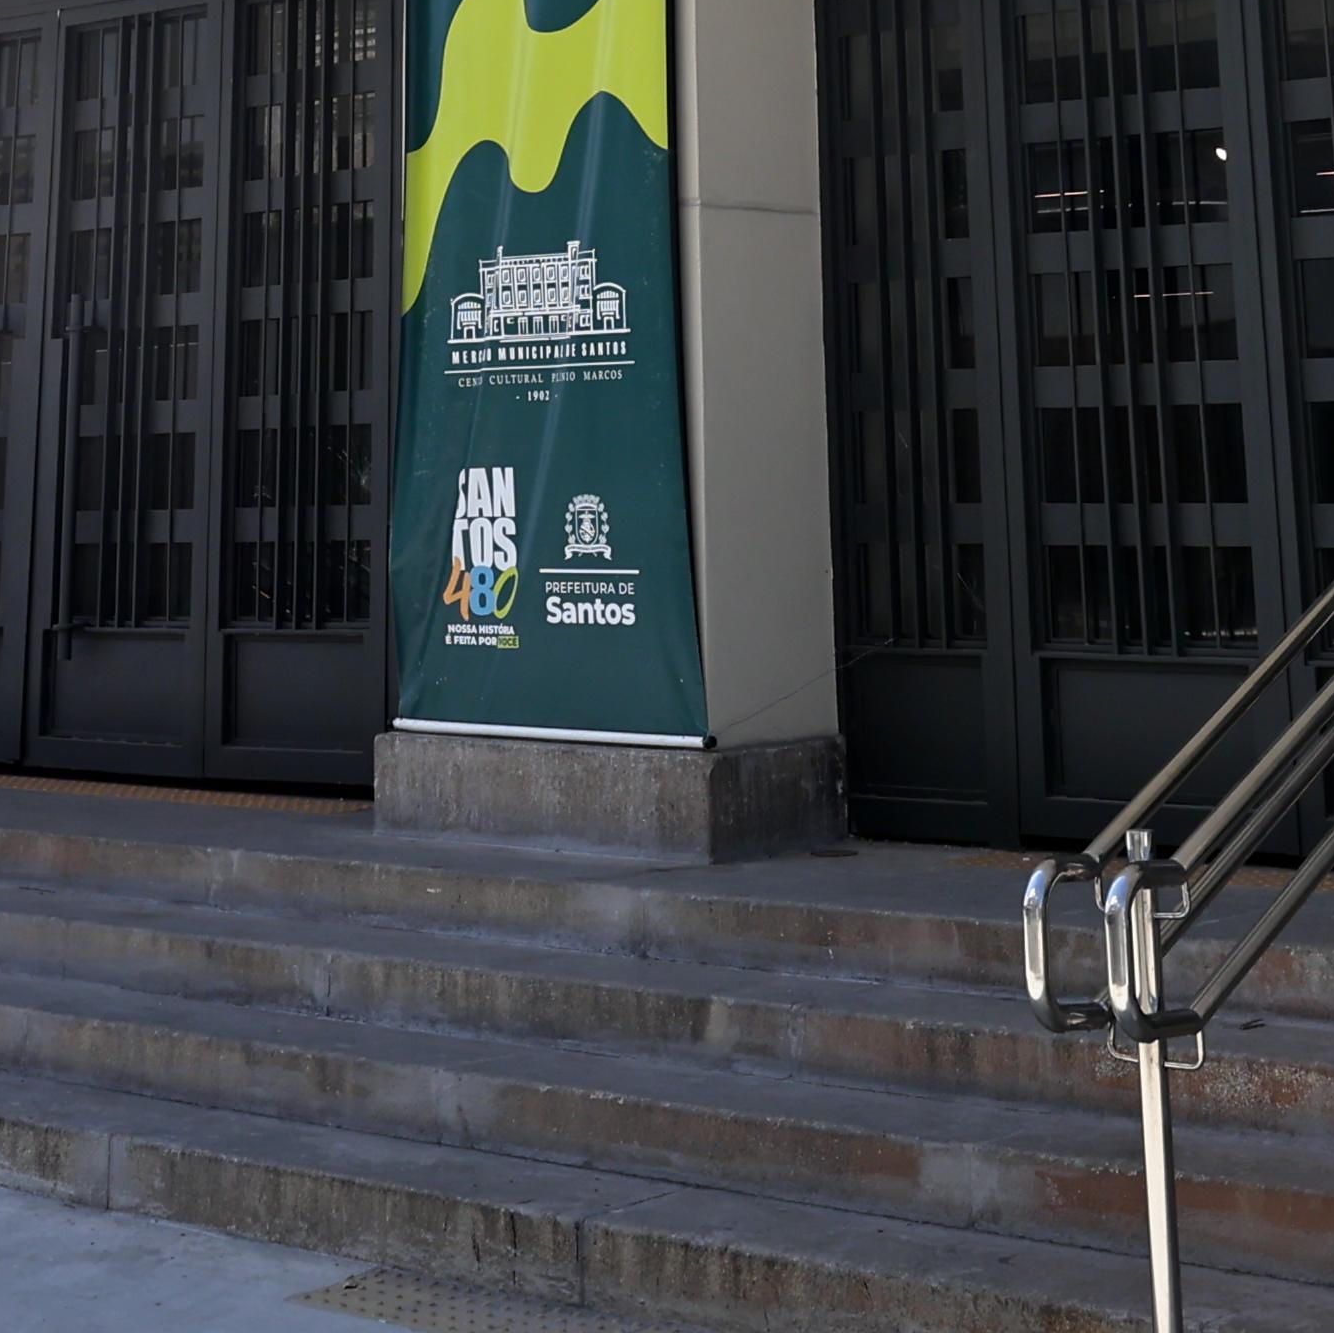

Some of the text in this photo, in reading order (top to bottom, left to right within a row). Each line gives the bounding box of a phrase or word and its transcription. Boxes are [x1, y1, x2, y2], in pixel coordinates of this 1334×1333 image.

[581, 341, 627, 356] SANTOS
[489, 373, 544, 385] CULTURAL
[583, 369, 623, 381] MARCOS
[443, 555, 519, 621] 480
[545, 582, 635, 595] PREFEITURA DE
[546, 596, 636, 625] Santos
[447, 622, 515, 635] NOSSA HISTÓRIA
[445, 632, 452, 645] É
[453, 635, 477, 645] FEITA
[478, 636, 497, 646] POR
